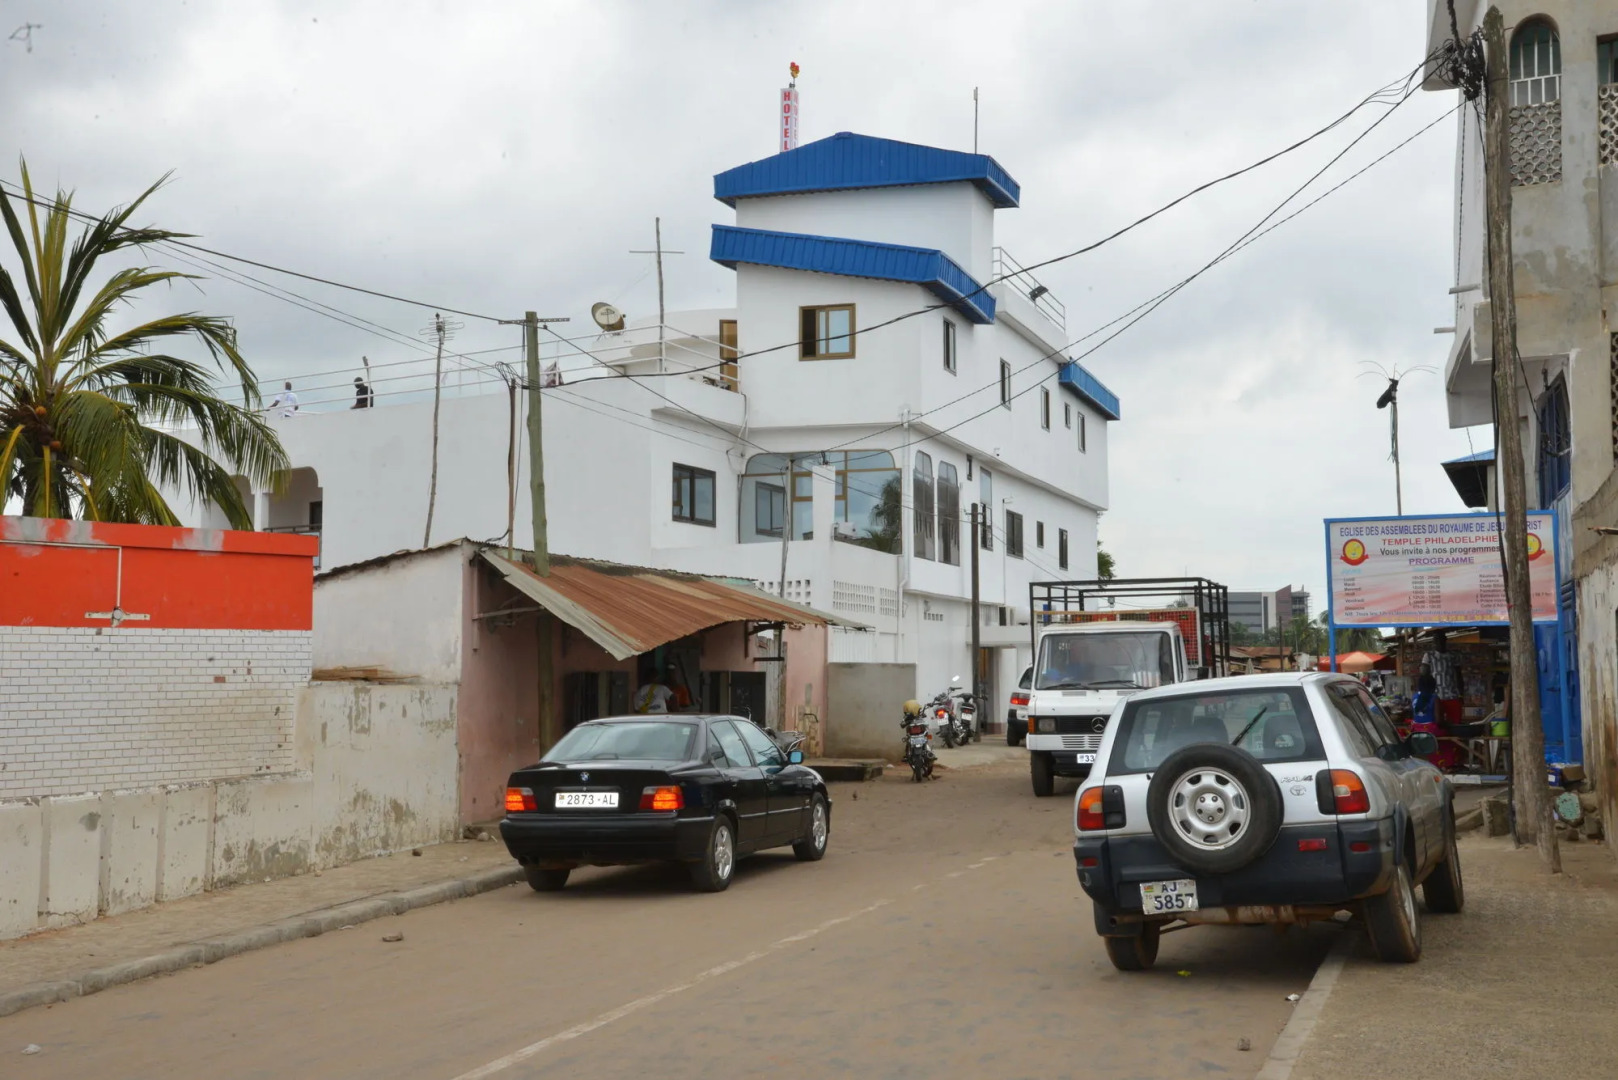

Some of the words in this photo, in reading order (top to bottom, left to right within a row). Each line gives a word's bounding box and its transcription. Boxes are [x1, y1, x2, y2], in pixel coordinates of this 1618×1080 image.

[1340, 526, 1364, 537] EGLISE
[1365, 525, 1380, 536] DES
[1380, 524, 1427, 535] ASSEMBLEES
[1428, 523, 1438, 534] DU
[1439, 522, 1474, 533] ROYAUME
[1475, 522, 1485, 532] DE
[1487, 521, 1508, 532] JESU
[1382, 537, 1422, 546] TEMPLE
[1424, 535, 1499, 545] PHILADELPHIE
[1380, 548, 1400, 556] Vous
[1402, 547, 1424, 555] invite
[1425, 547, 1431, 555] à
[1432, 547, 1448, 555] nos
[1449, 545, 1502, 556] programmes
[1409, 556, 1475, 566] PROGRAMME
[1162, 882, 1178, 893] AJ
[1154, 893, 1195, 911] 5857
